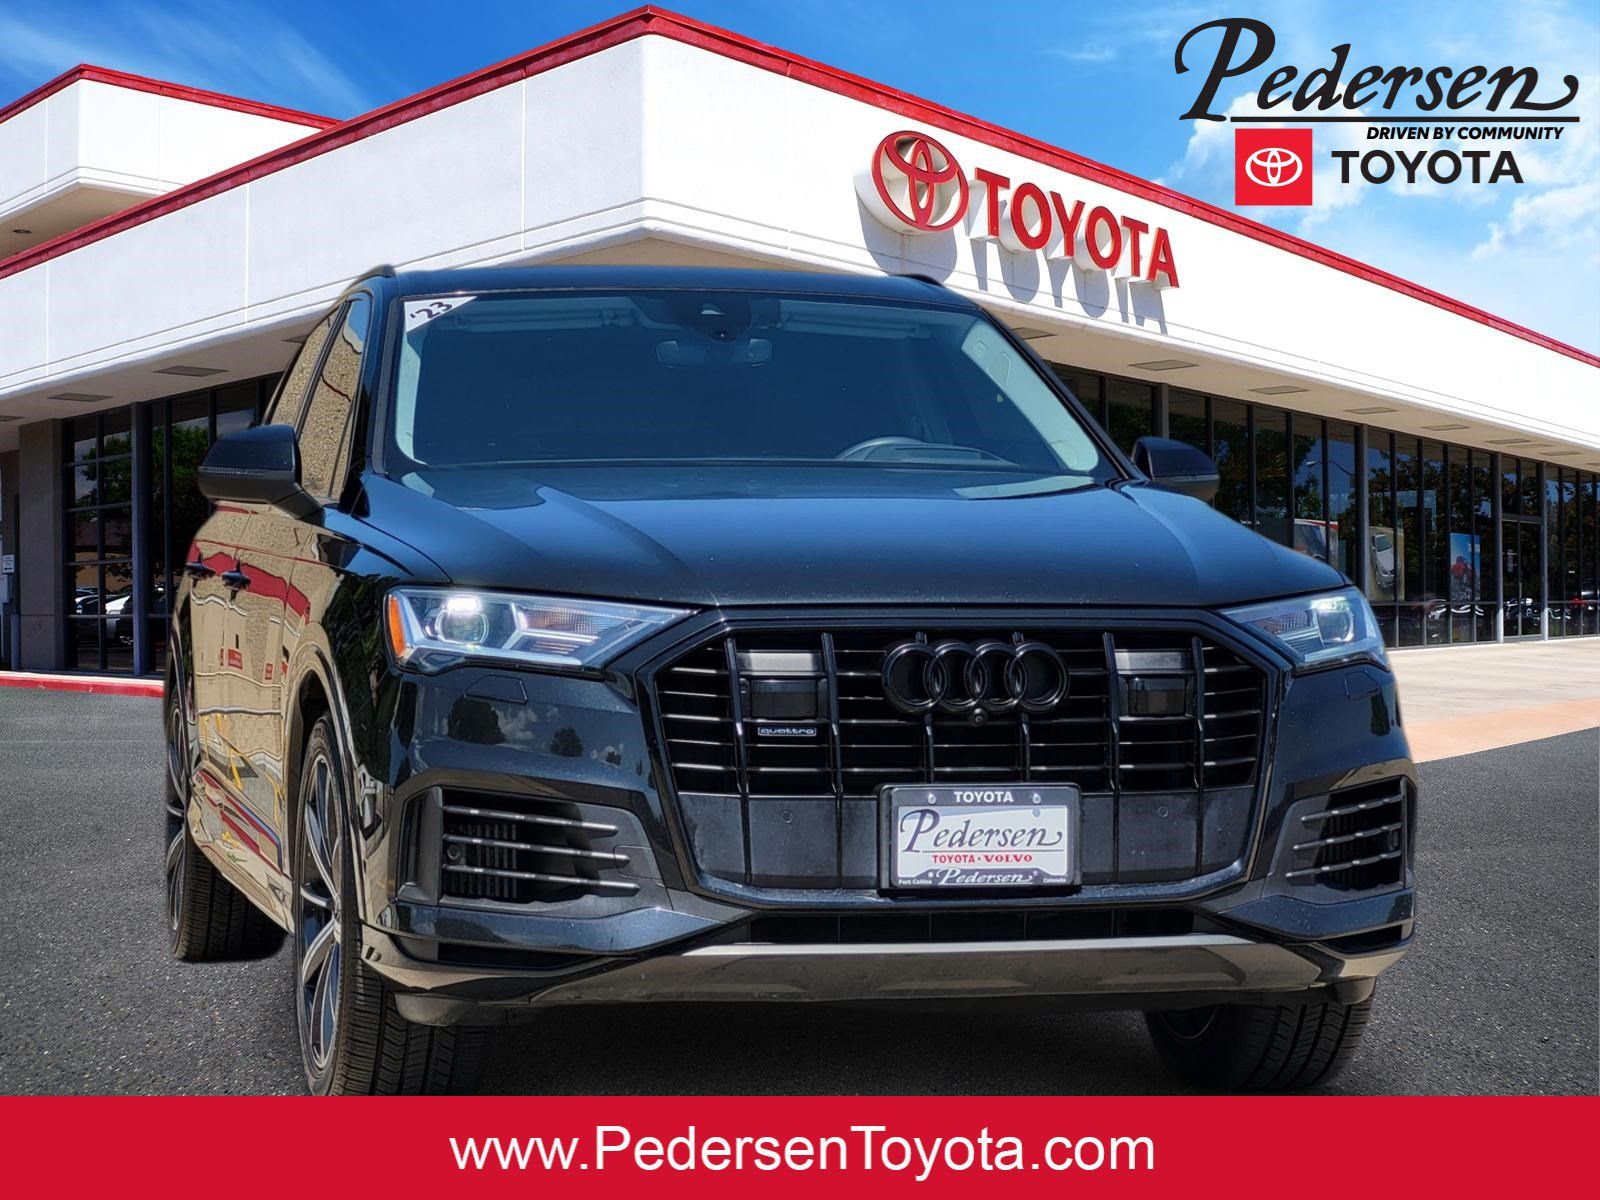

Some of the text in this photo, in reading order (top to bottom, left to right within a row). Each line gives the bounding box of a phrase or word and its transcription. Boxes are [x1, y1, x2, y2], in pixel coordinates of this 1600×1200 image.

[974, 167, 1180, 289] TOYOTA
[760, 727, 815, 736] quattro
[953, 791, 1014, 804] TOYOTA
[900, 808, 1063, 853] Pedersen
[932, 854, 1033, 864] TOYOTA VOLVO
[936, 868, 1033, 885] Pedersen
